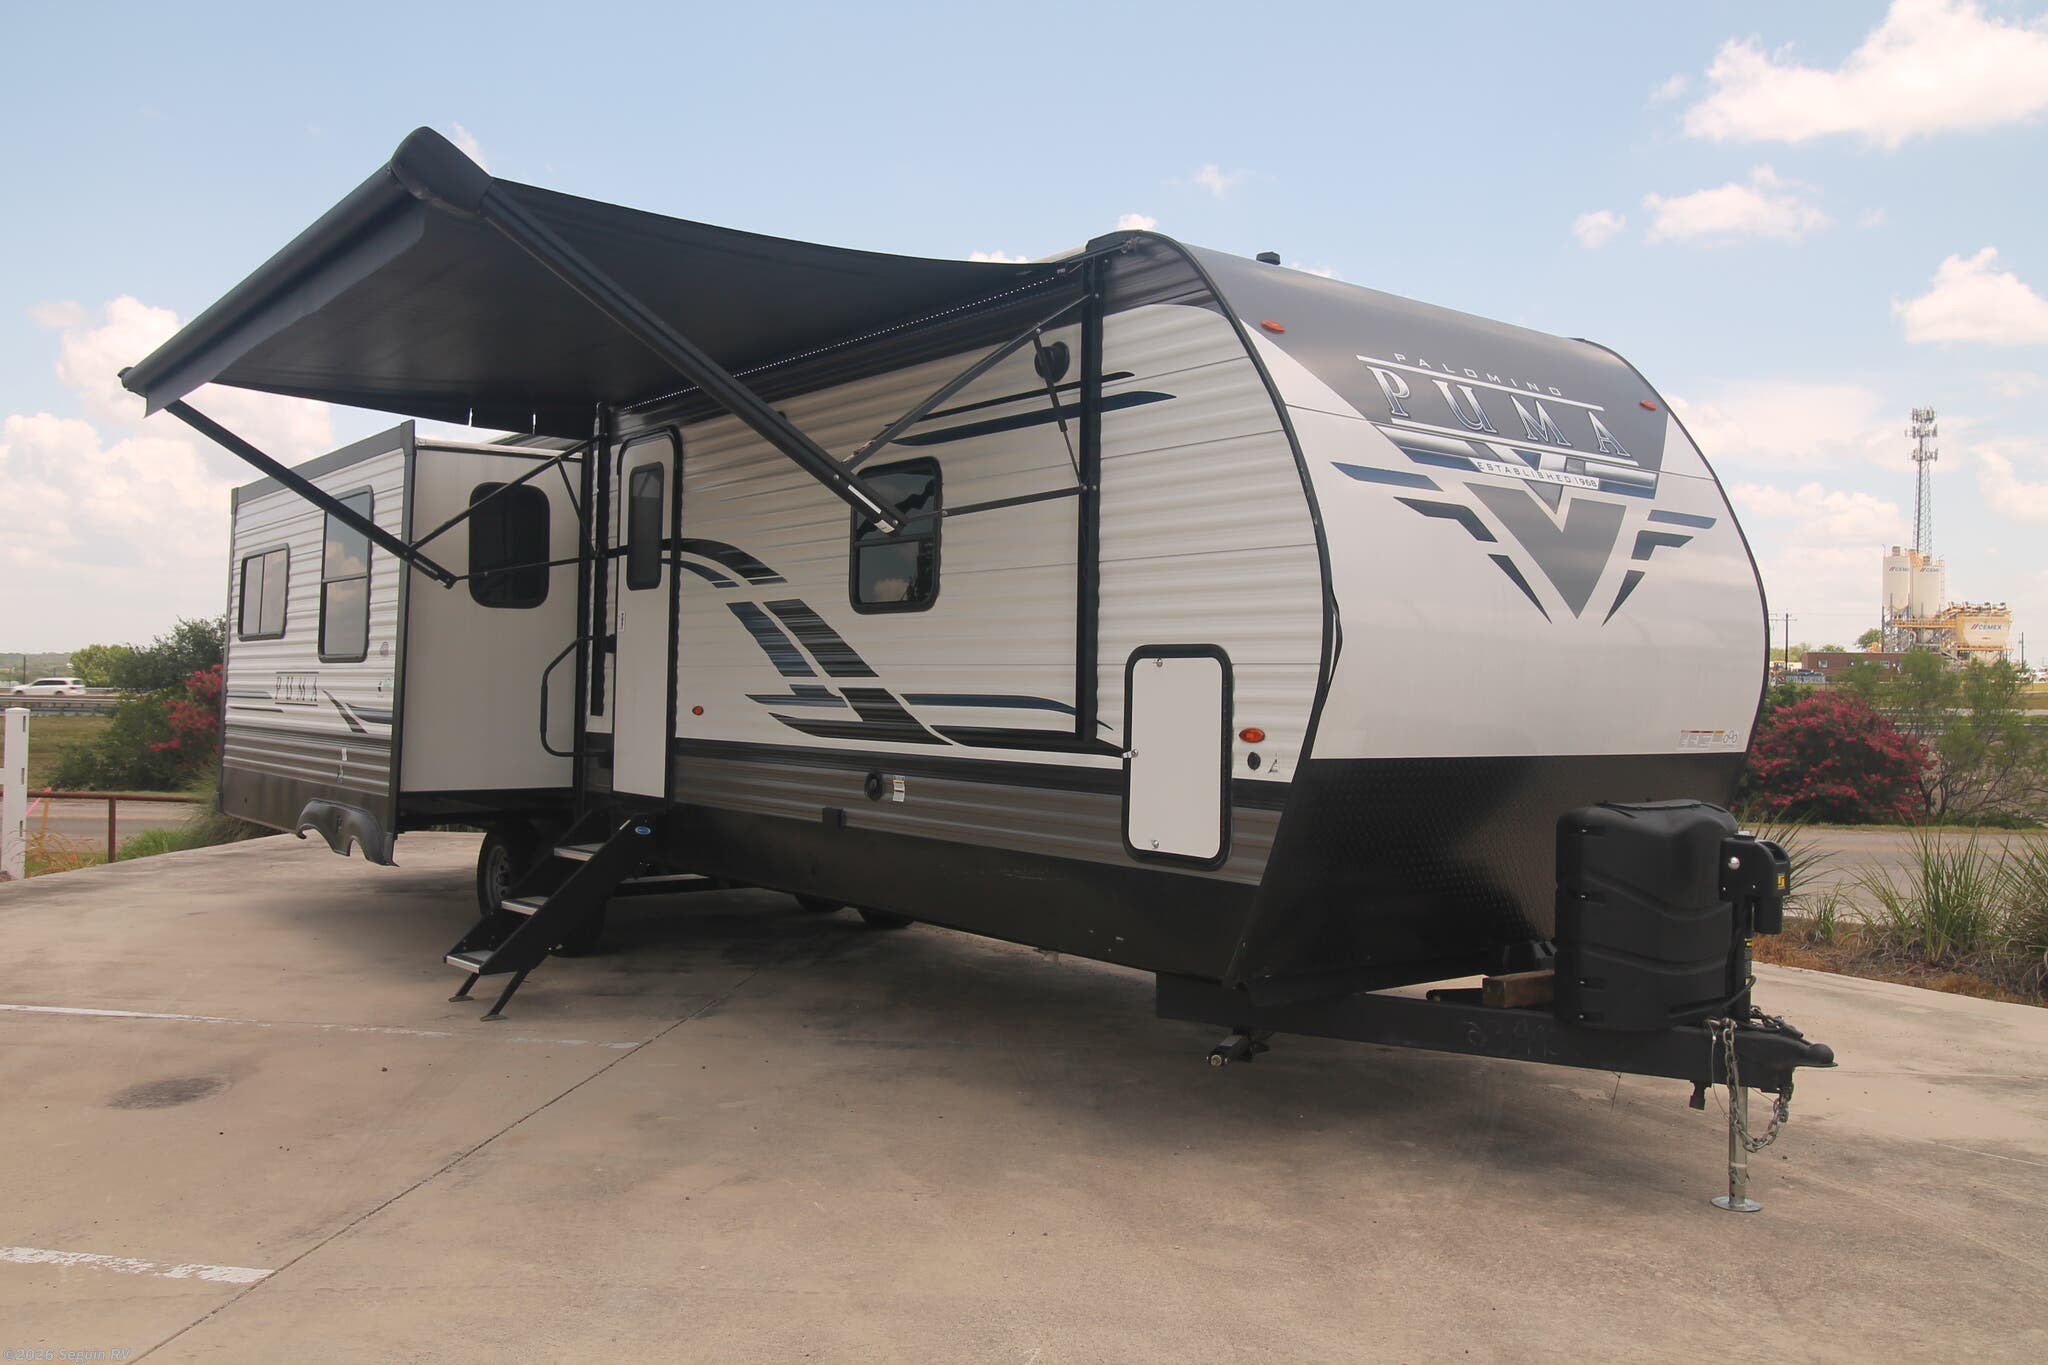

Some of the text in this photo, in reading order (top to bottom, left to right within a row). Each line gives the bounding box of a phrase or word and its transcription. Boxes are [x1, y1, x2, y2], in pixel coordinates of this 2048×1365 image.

[1393, 352, 1562, 397] PALOMINO
[1366, 365, 1632, 457] PUMA
[1476, 461, 1598, 488] ESTABLISHED 1968
